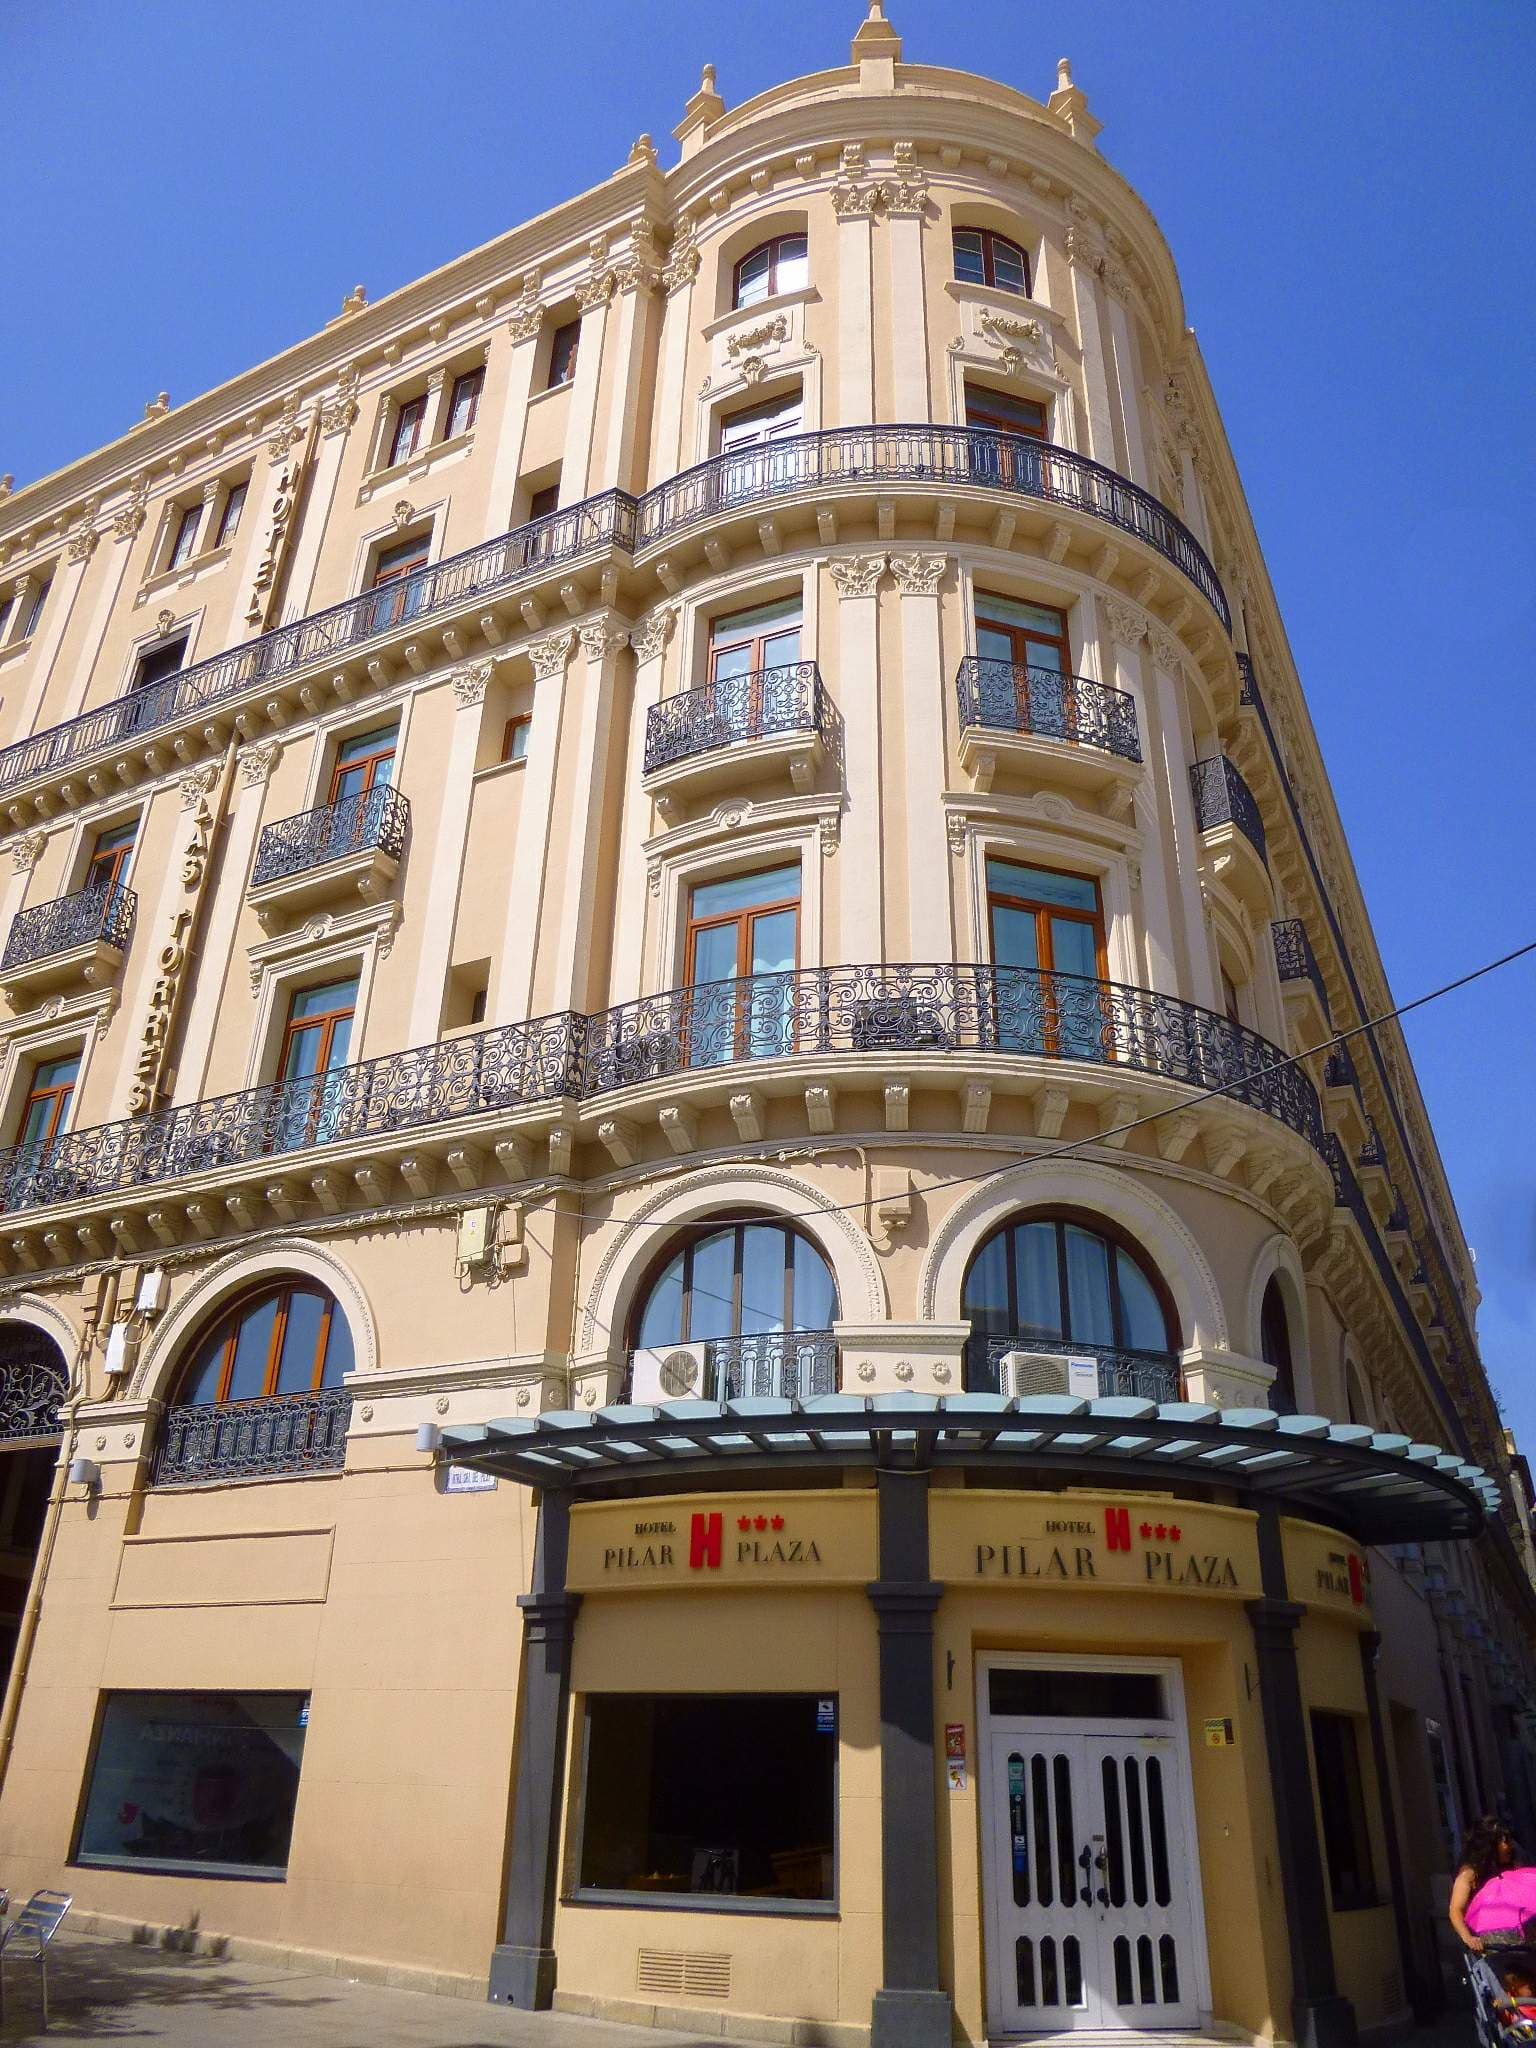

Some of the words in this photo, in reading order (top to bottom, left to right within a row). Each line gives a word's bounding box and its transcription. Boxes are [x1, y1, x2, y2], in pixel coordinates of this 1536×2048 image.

[244, 459, 300, 622] HOTEL
[180, 796, 214, 885] LAS
[125, 908, 192, 1112] TORRES
[603, 1544, 674, 1569] PILAR
[689, 1512, 723, 1569] H
[736, 1540, 822, 1563] PLAZA
[634, 1521, 677, 1536] HOTEL
[974, 1544, 1098, 1577] PILAR
[1104, 1507, 1132, 1553] H
[1144, 1551, 1239, 1586] PLAZA
[1045, 1519, 1096, 1535] HOTEL
